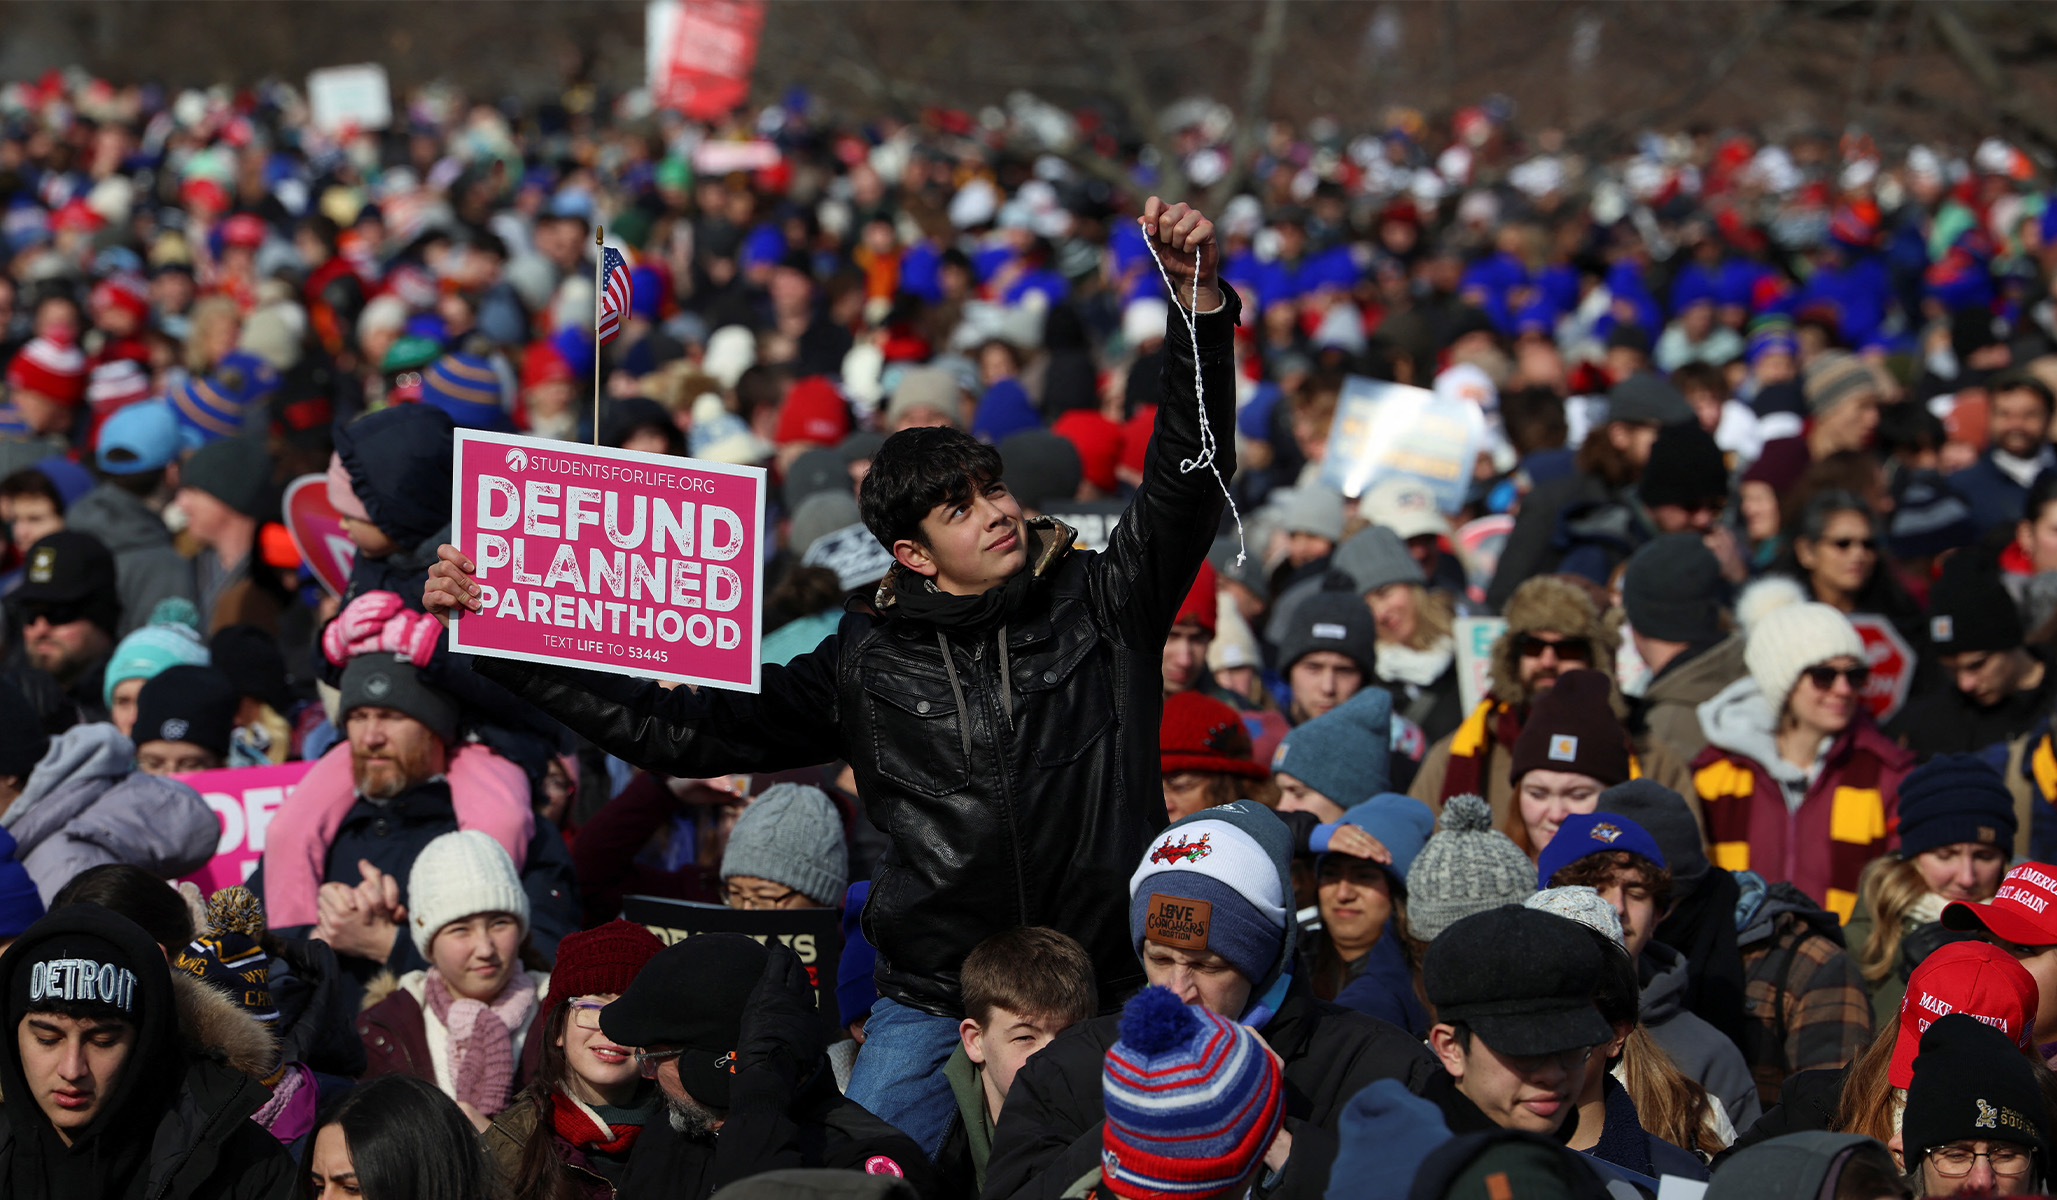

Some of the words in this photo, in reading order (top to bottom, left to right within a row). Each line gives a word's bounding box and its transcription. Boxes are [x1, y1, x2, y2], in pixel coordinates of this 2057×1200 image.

[530, 455, 715, 494] STUDENTSFORLIFE.ORG
[476, 473, 744, 561] DEFUND
[475, 532, 743, 612] PLANNED
[476, 584, 741, 650] PARENTHOOD
[543, 634, 573, 650] TEXT
[577, 638, 603, 654] LIFE
[607, 643, 624, 657] TO
[628, 647, 668, 662] 53445
[1160, 902, 1195, 922] LOVE
[2010, 888, 2050, 914] AGAIN
[1148, 913, 1206, 937] CONQUERS
[1158, 929, 1191, 941] ABORTION
[30, 958, 138, 1013] DETROIT
[1918, 991, 1953, 1017] MAKE
